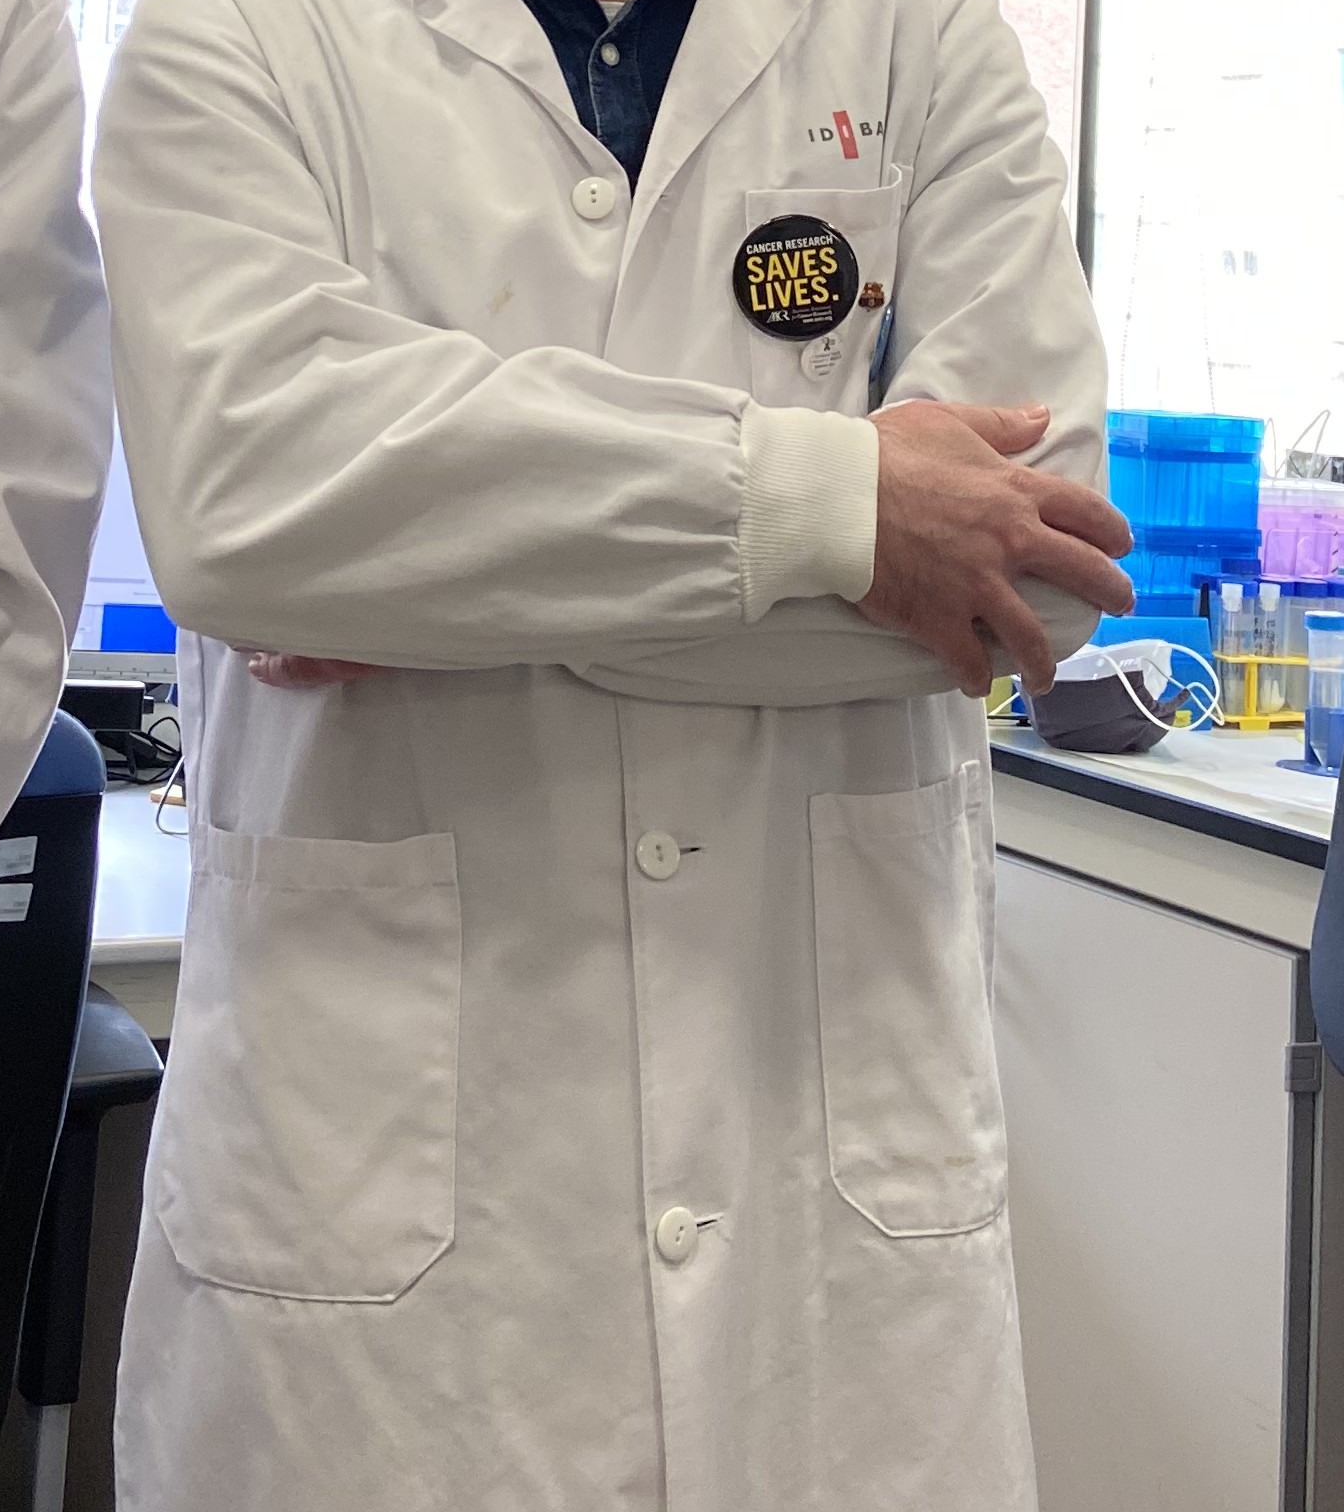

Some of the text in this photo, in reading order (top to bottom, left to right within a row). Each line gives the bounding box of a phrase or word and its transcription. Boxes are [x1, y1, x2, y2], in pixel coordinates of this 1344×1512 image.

[746, 235, 833, 255] CANCER RESEARCH
[746, 247, 838, 283] SAVES
[750, 276, 839, 312] LIVES.
